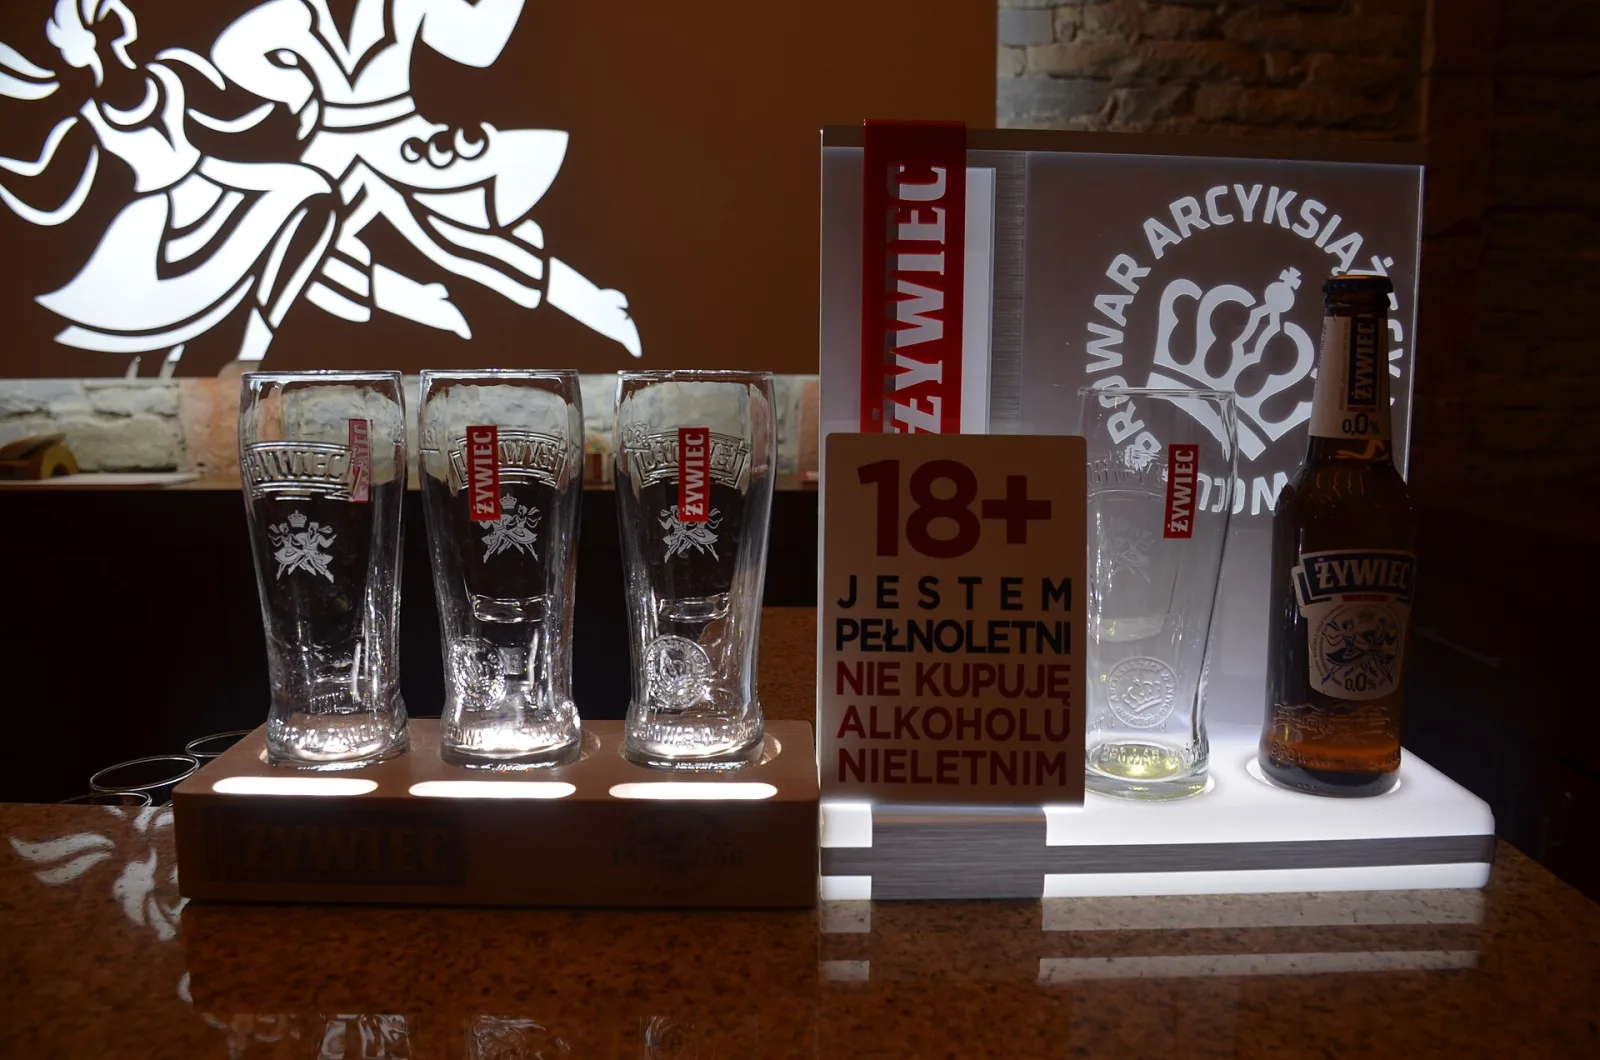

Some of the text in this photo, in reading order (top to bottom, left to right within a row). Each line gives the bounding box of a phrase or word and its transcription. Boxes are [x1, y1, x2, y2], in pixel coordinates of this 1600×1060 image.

[1086, 253, 1161, 455] BROWAR
[473, 431, 495, 514] ŻYWIEC
[682, 433, 704, 516] ŻYWIEC
[1167, 450, 1194, 533] ŻYWIEC
[857, 459, 1052, 559] 18+
[837, 575, 1072, 611] JESTEM
[1314, 558, 1410, 589] ŻYWIEC
[836, 618, 1071, 655] PEŁNOLETNI
[836, 661, 1071, 706] NIE KUPUJĘ
[837, 705, 1071, 743] ALKOHOLU
[838, 748, 1067, 786] NIELETNIM
